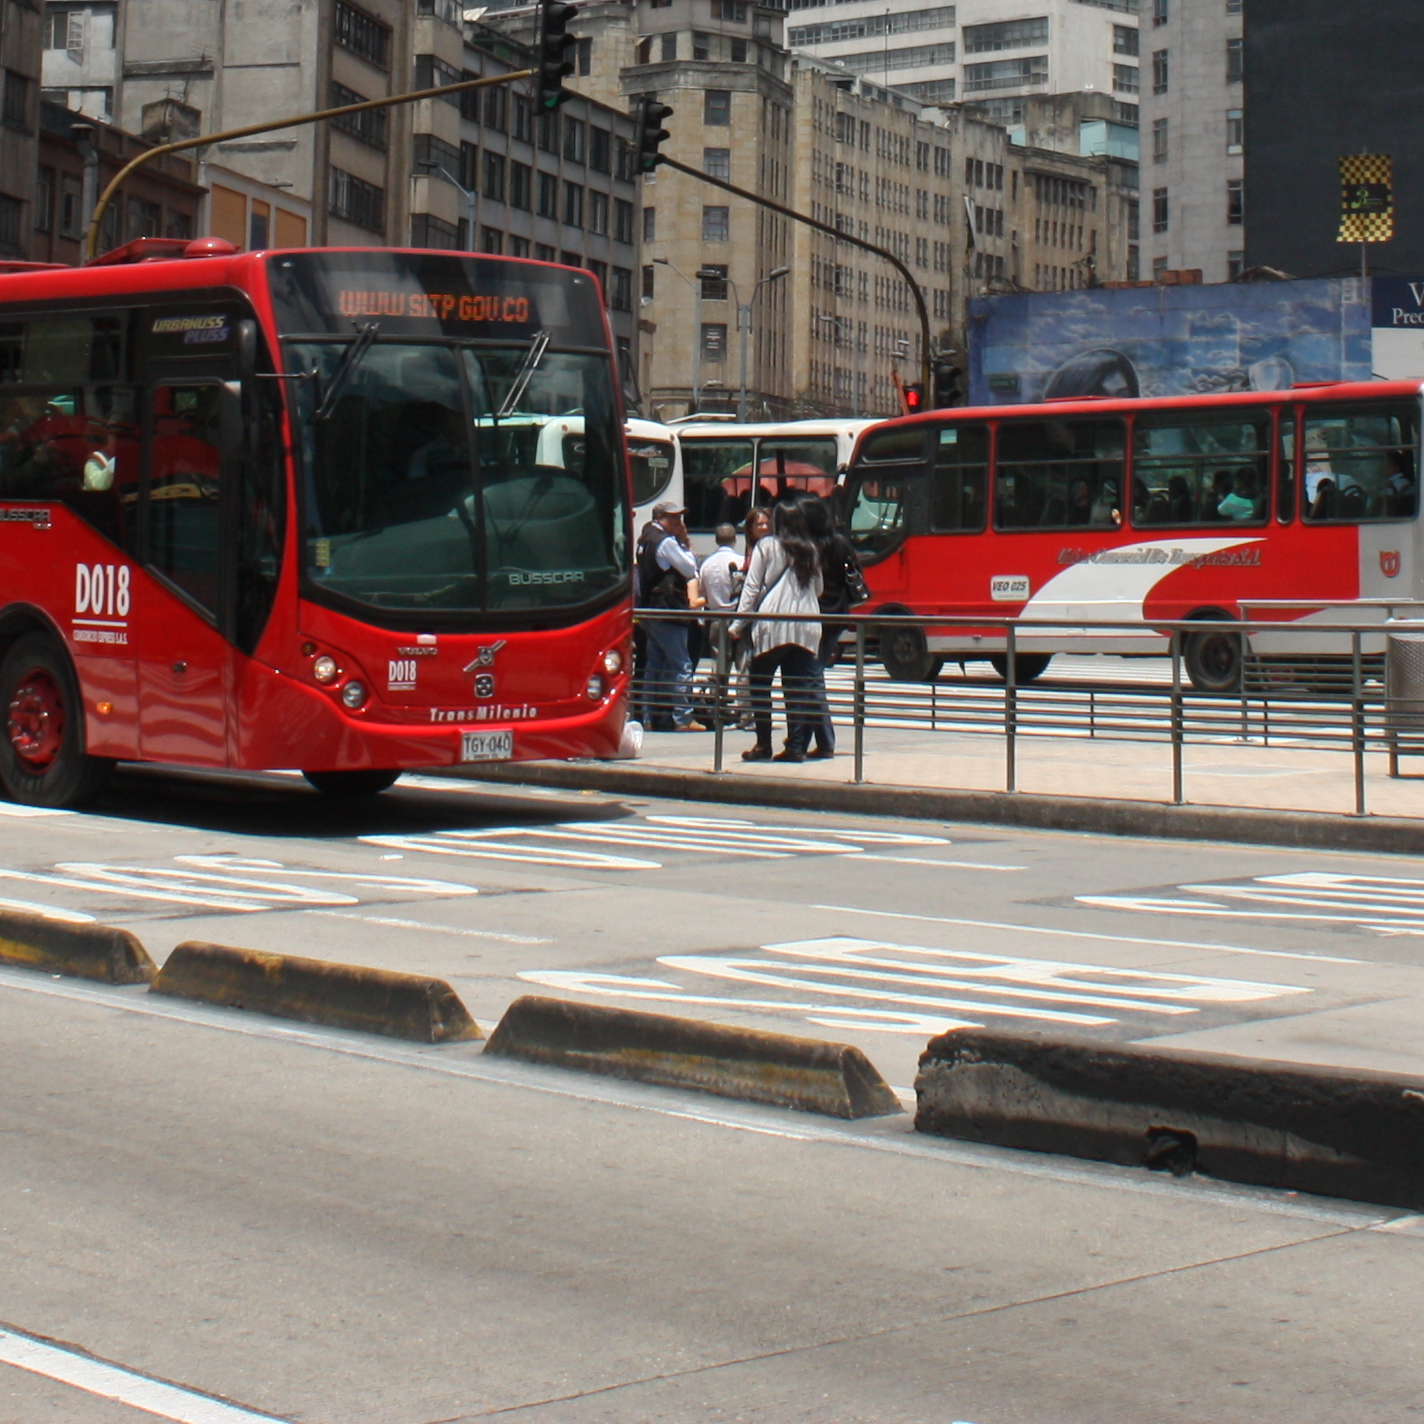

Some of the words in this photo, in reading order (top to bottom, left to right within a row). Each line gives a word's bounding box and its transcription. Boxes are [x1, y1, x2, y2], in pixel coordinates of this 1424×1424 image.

[508, 571, 585, 586] BUSSCAR
[74, 562, 131, 617] D018
[388, 660, 417, 681] D018
[429, 703, 538, 722] TransMilenio
